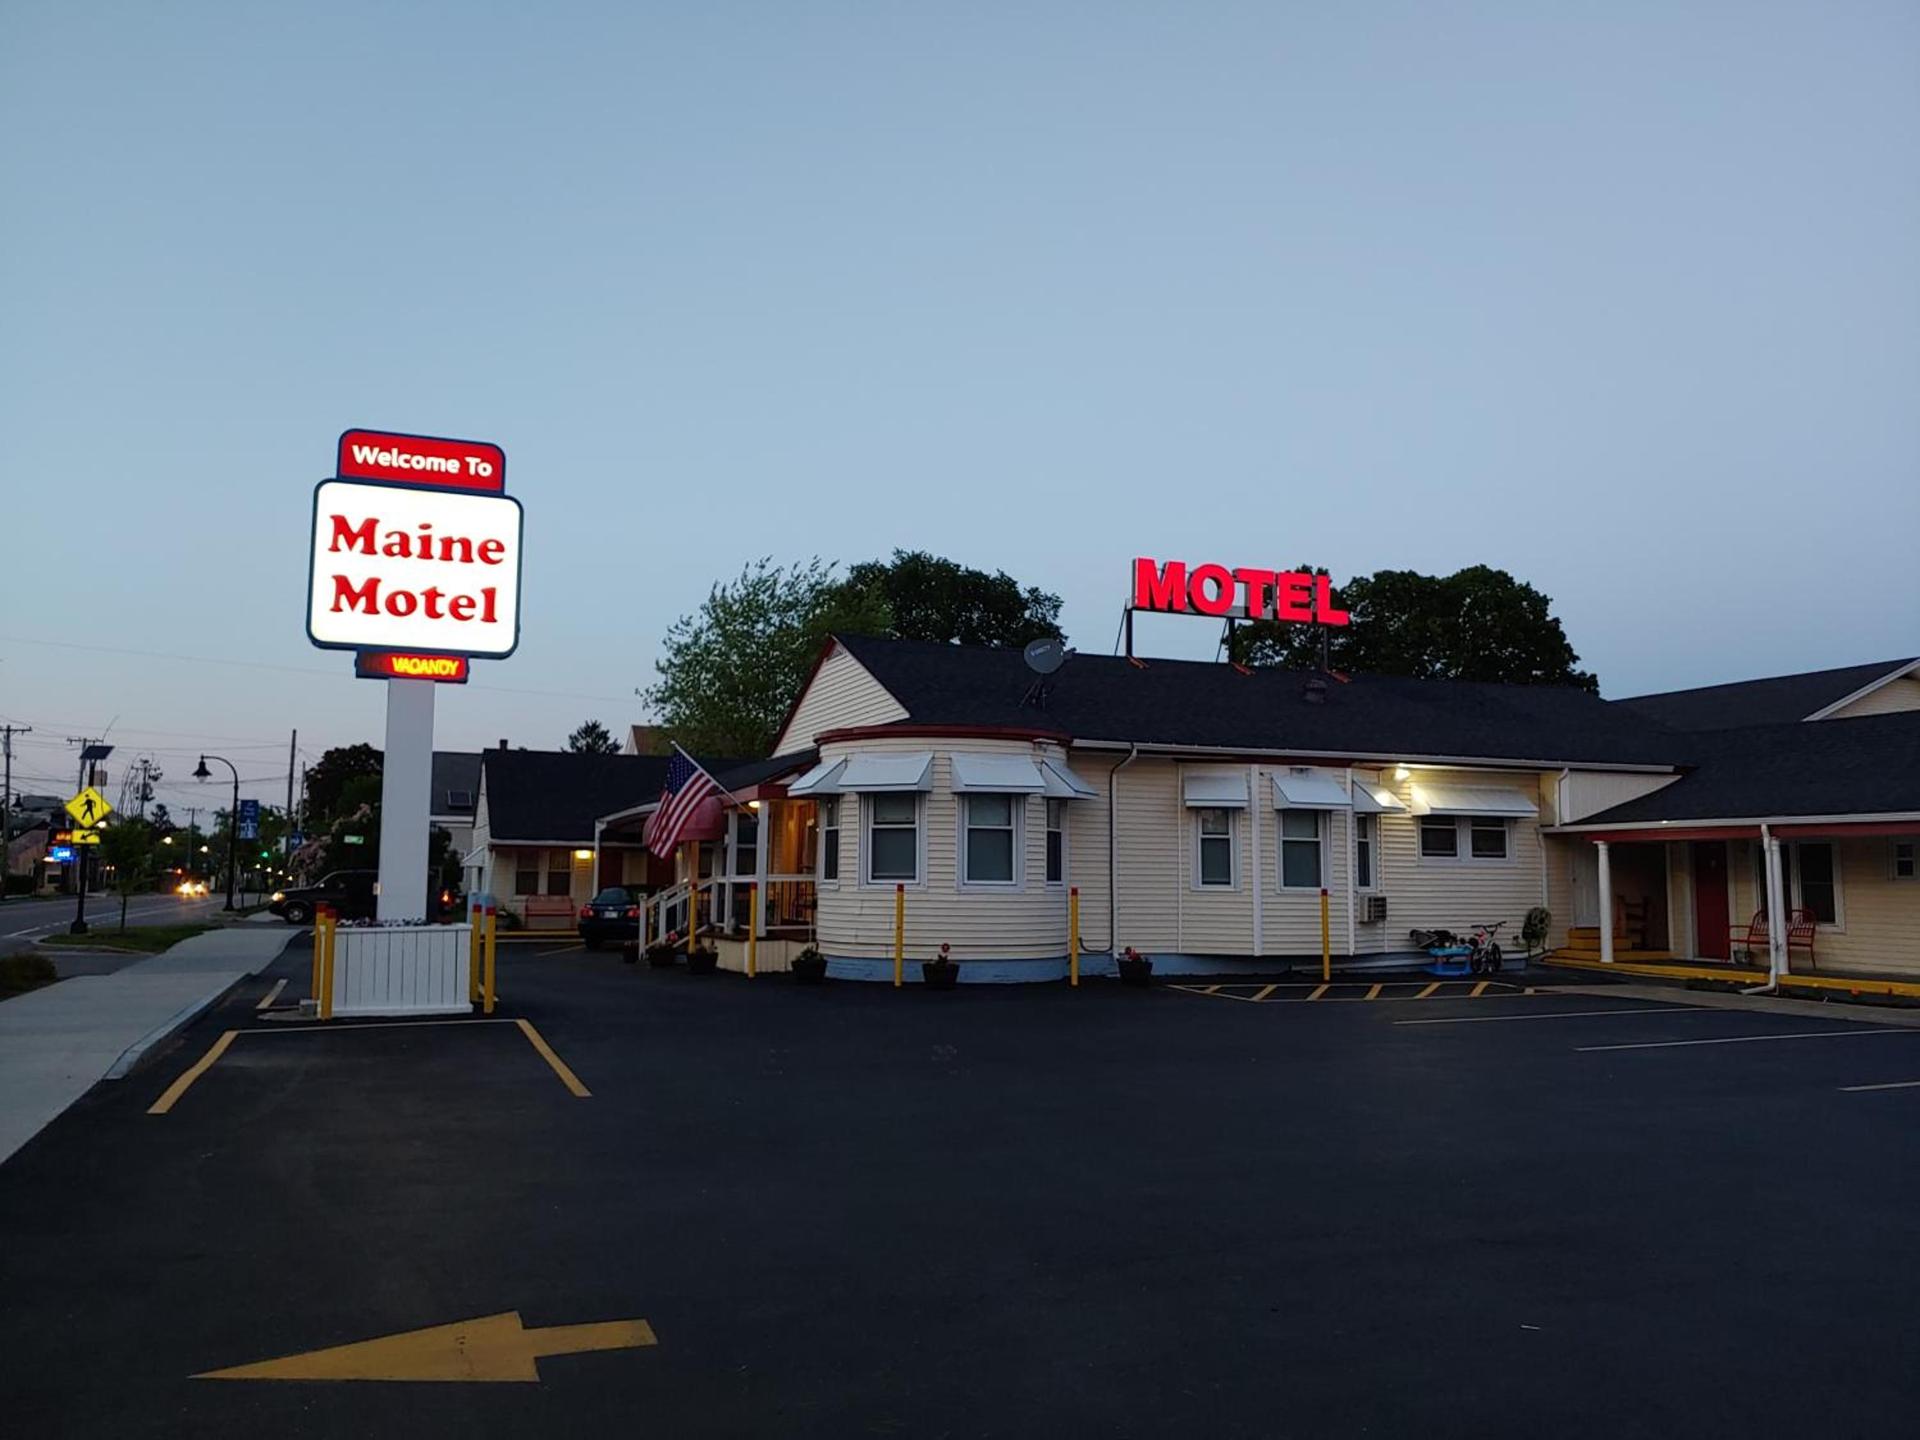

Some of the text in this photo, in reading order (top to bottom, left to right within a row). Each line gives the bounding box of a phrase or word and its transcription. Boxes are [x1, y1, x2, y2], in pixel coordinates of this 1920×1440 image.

[352, 445, 493, 477] Welcome To
[328, 514, 505, 565] Maine
[330, 575, 498, 623] Motel
[1134, 557, 1349, 625] MOTEL
[392, 656, 459, 676] VACANCY
